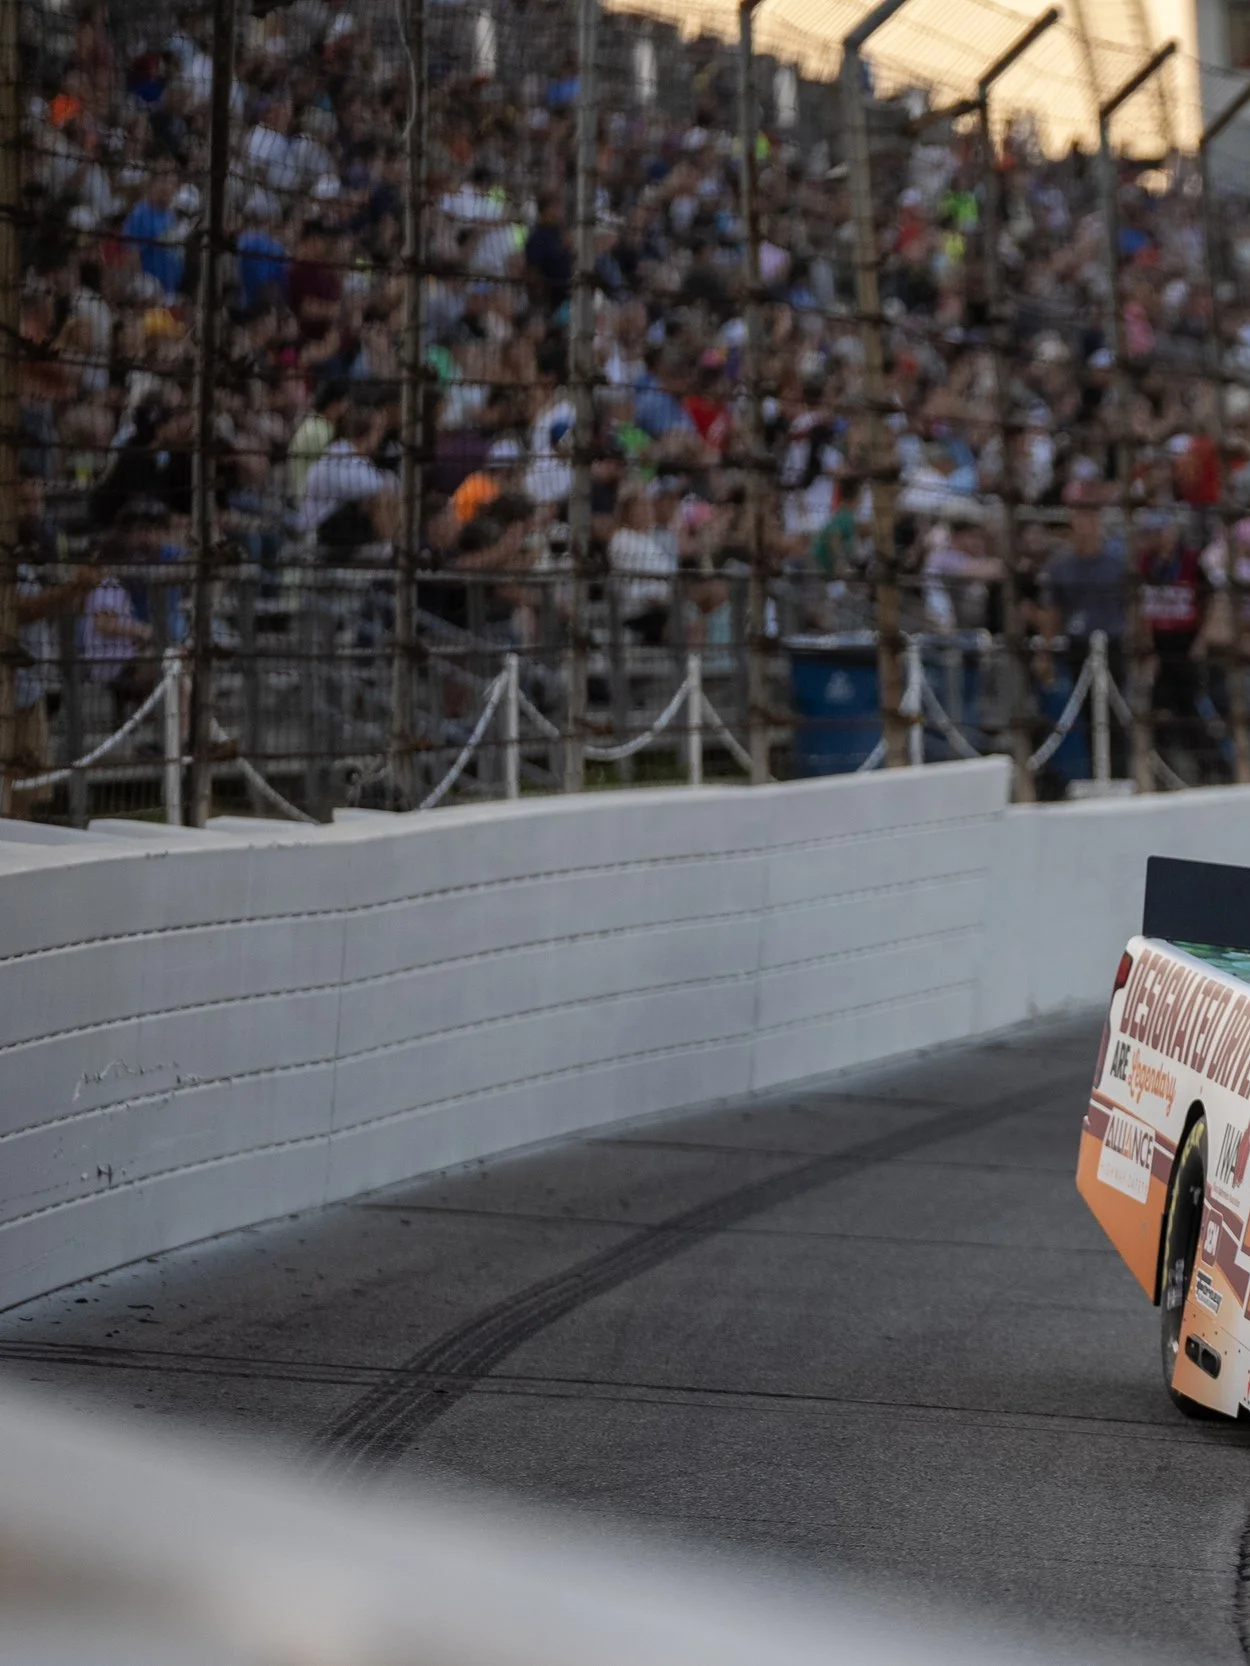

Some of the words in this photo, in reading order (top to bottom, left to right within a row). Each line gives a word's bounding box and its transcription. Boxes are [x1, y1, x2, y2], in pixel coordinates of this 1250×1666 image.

[1119, 949, 1235, 1074] DESIGNATED
[1110, 1040, 1131, 1081] ARE
[1105, 1115, 1153, 1170] ALLIANCE
